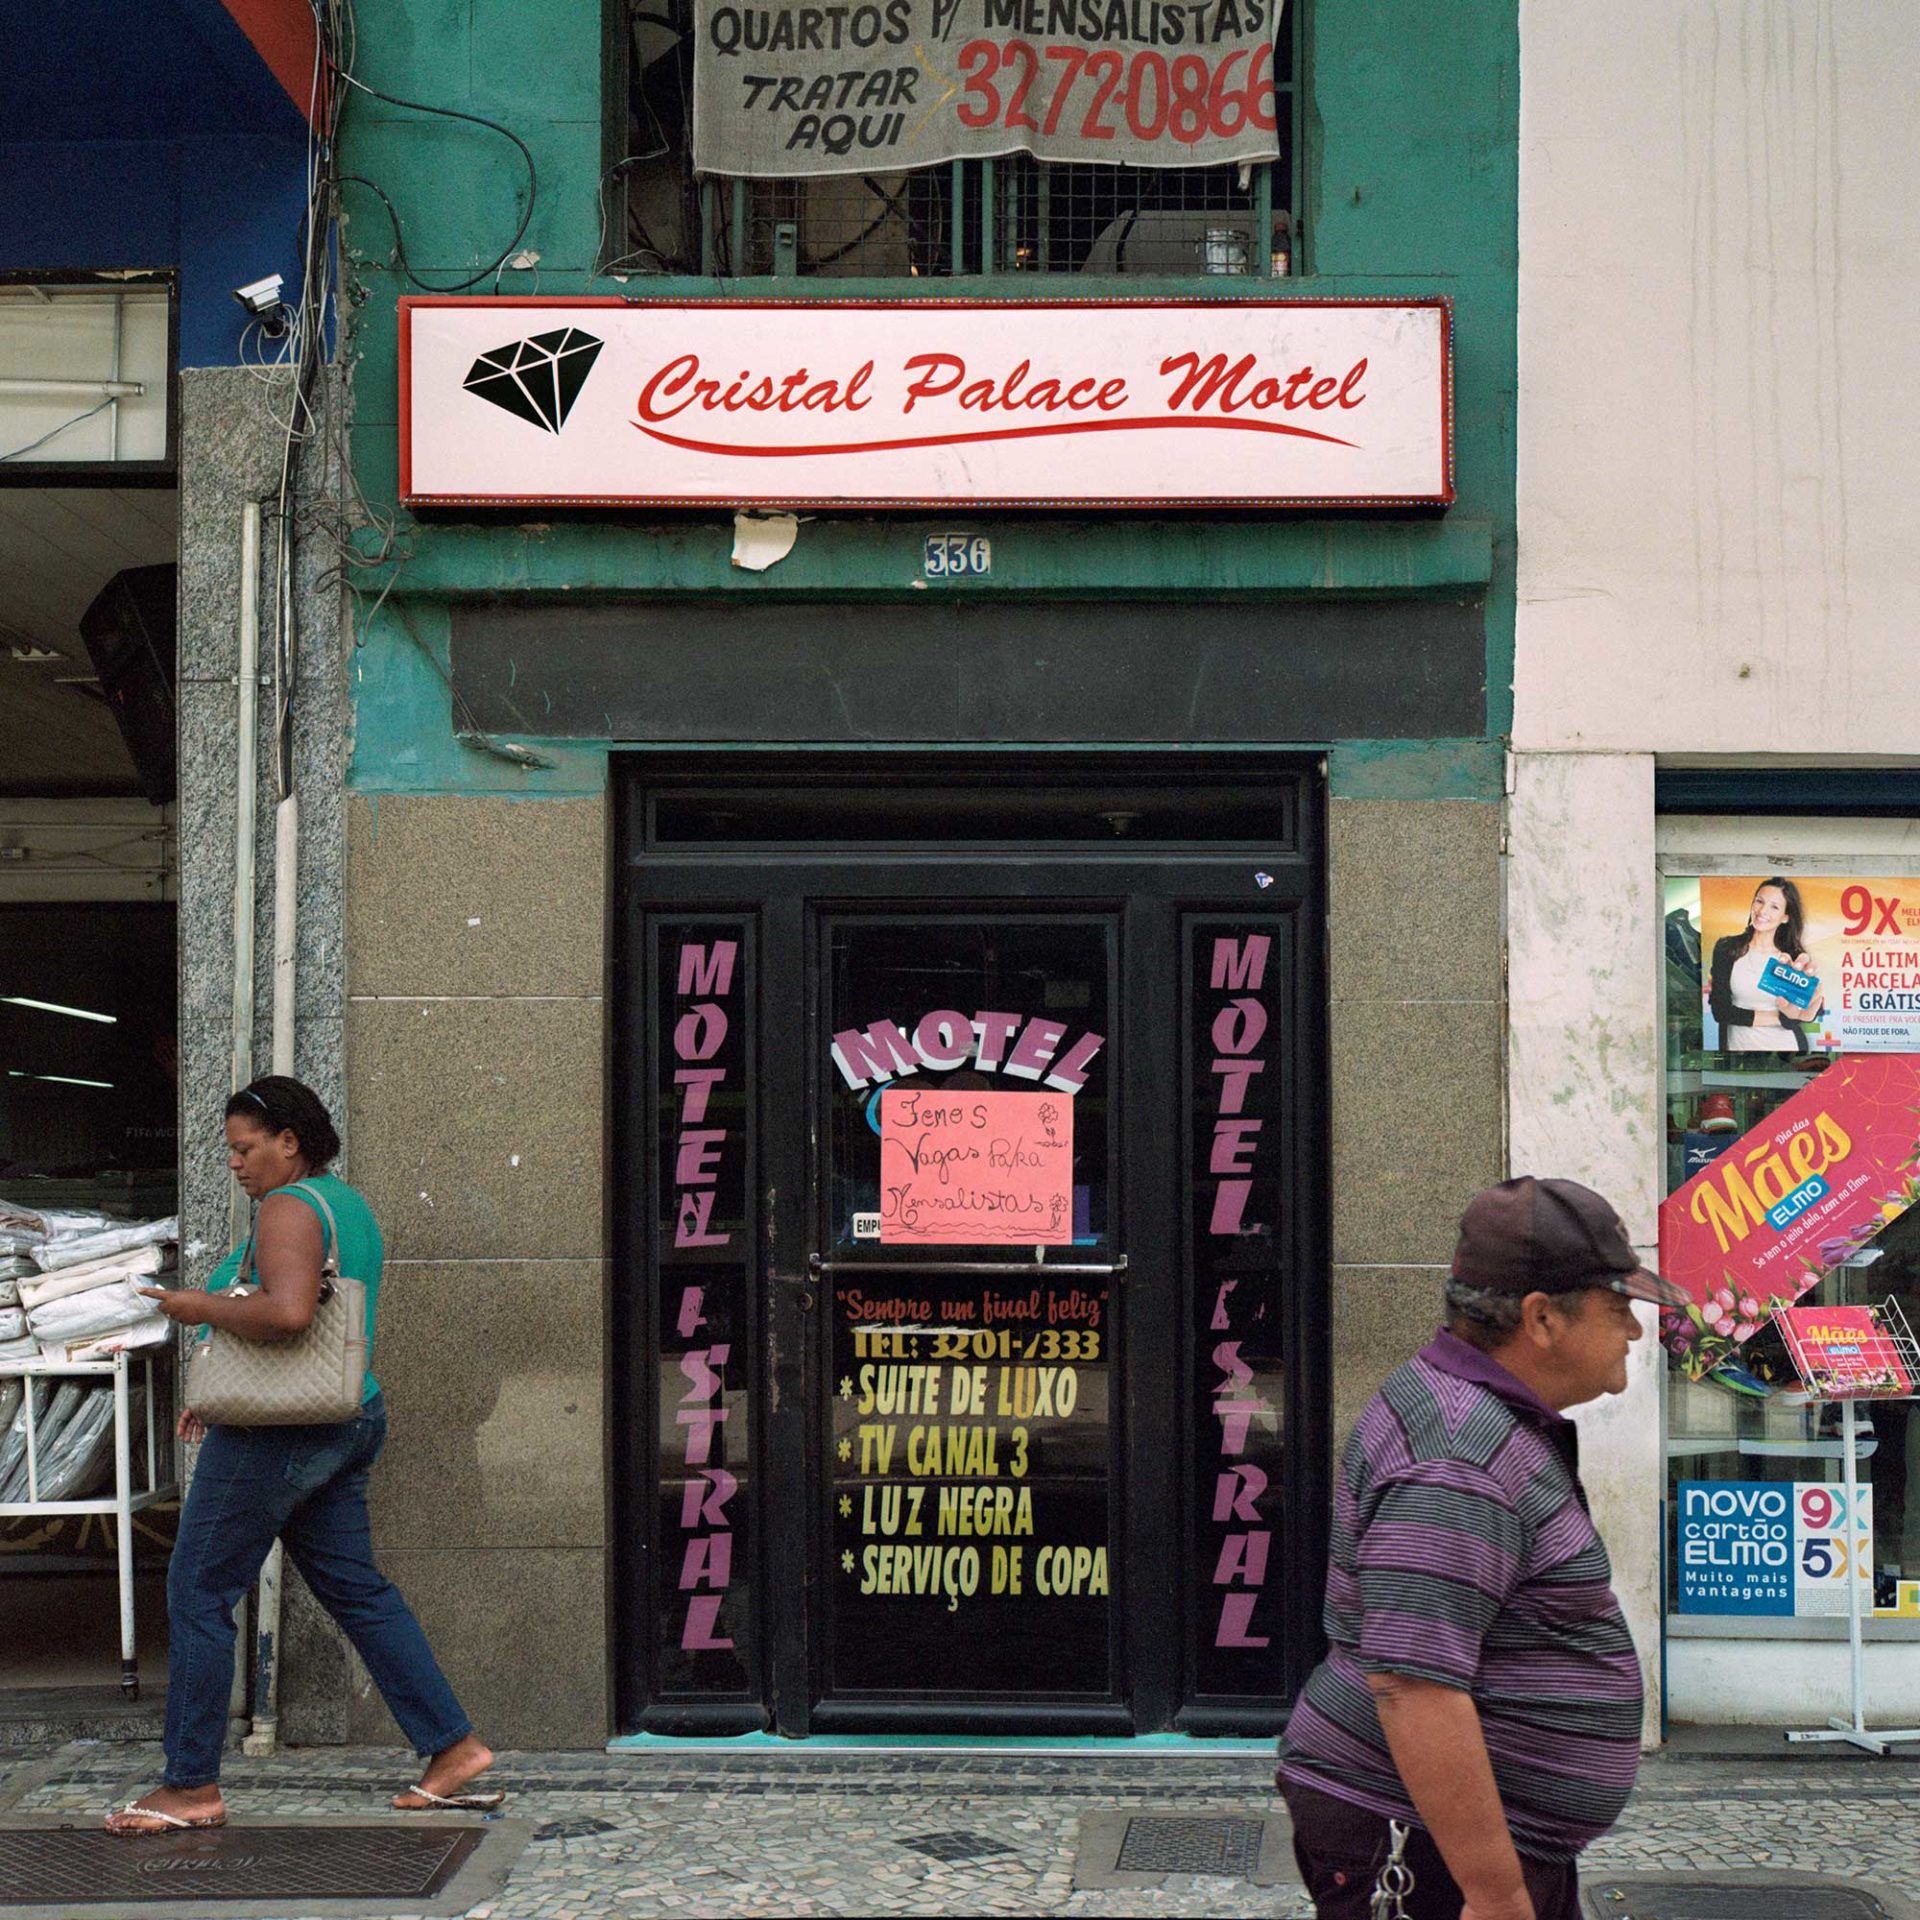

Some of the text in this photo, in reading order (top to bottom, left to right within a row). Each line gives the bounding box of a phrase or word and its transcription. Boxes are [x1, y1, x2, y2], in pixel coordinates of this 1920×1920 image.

[710, 0, 911, 56] QUARTOS
[984, 0, 1264, 45] MENSALISTAS
[742, 67, 919, 112] TRATAR
[785, 113, 905, 155] AQUI
[637, 351, 1367, 422] Cristal Palace Motel
[925, 537, 991, 573] 336
[1773, 966, 1809, 987] ELMO
[1842, 952, 1853, 967] A
[1843, 988, 1852, 1009] É
[831, 1010, 1105, 1095] MOTEL
[1859, 1027, 1879, 1036] FIQUE
[674, 941, 736, 1247] MOTEL
[1210, 935, 1271, 1233] MOTEL
[1775, 1117, 1810, 1145] Dia das
[884, 1133, 981, 1184] Vagas
[1690, 1112, 1851, 1254] Mães
[1772, 1181, 1822, 1225] ELMO
[1752, 1257, 1766, 1269] Se
[1763, 1245, 1781, 1260] tem
[941, 1299, 976, 1319] um
[984, 1289, 1042, 1324] final
[1807, 1325, 1868, 1344] Mães
[858, 1364, 1078, 1420] SUITE DE LUXO
[858, 1425, 1029, 1478] TV CANAL 3
[862, 1485, 1034, 1536] LUZ NEGRA
[1685, 1519, 1787, 1540] cartão
[1685, 1540, 1787, 1566] ELMO
[860, 1545, 1110, 1612] SERVIÇO DE COPA
[1685, 1585, 1787, 1600] vantagens
[1686, 1571, 1787, 1583] Muito mais
